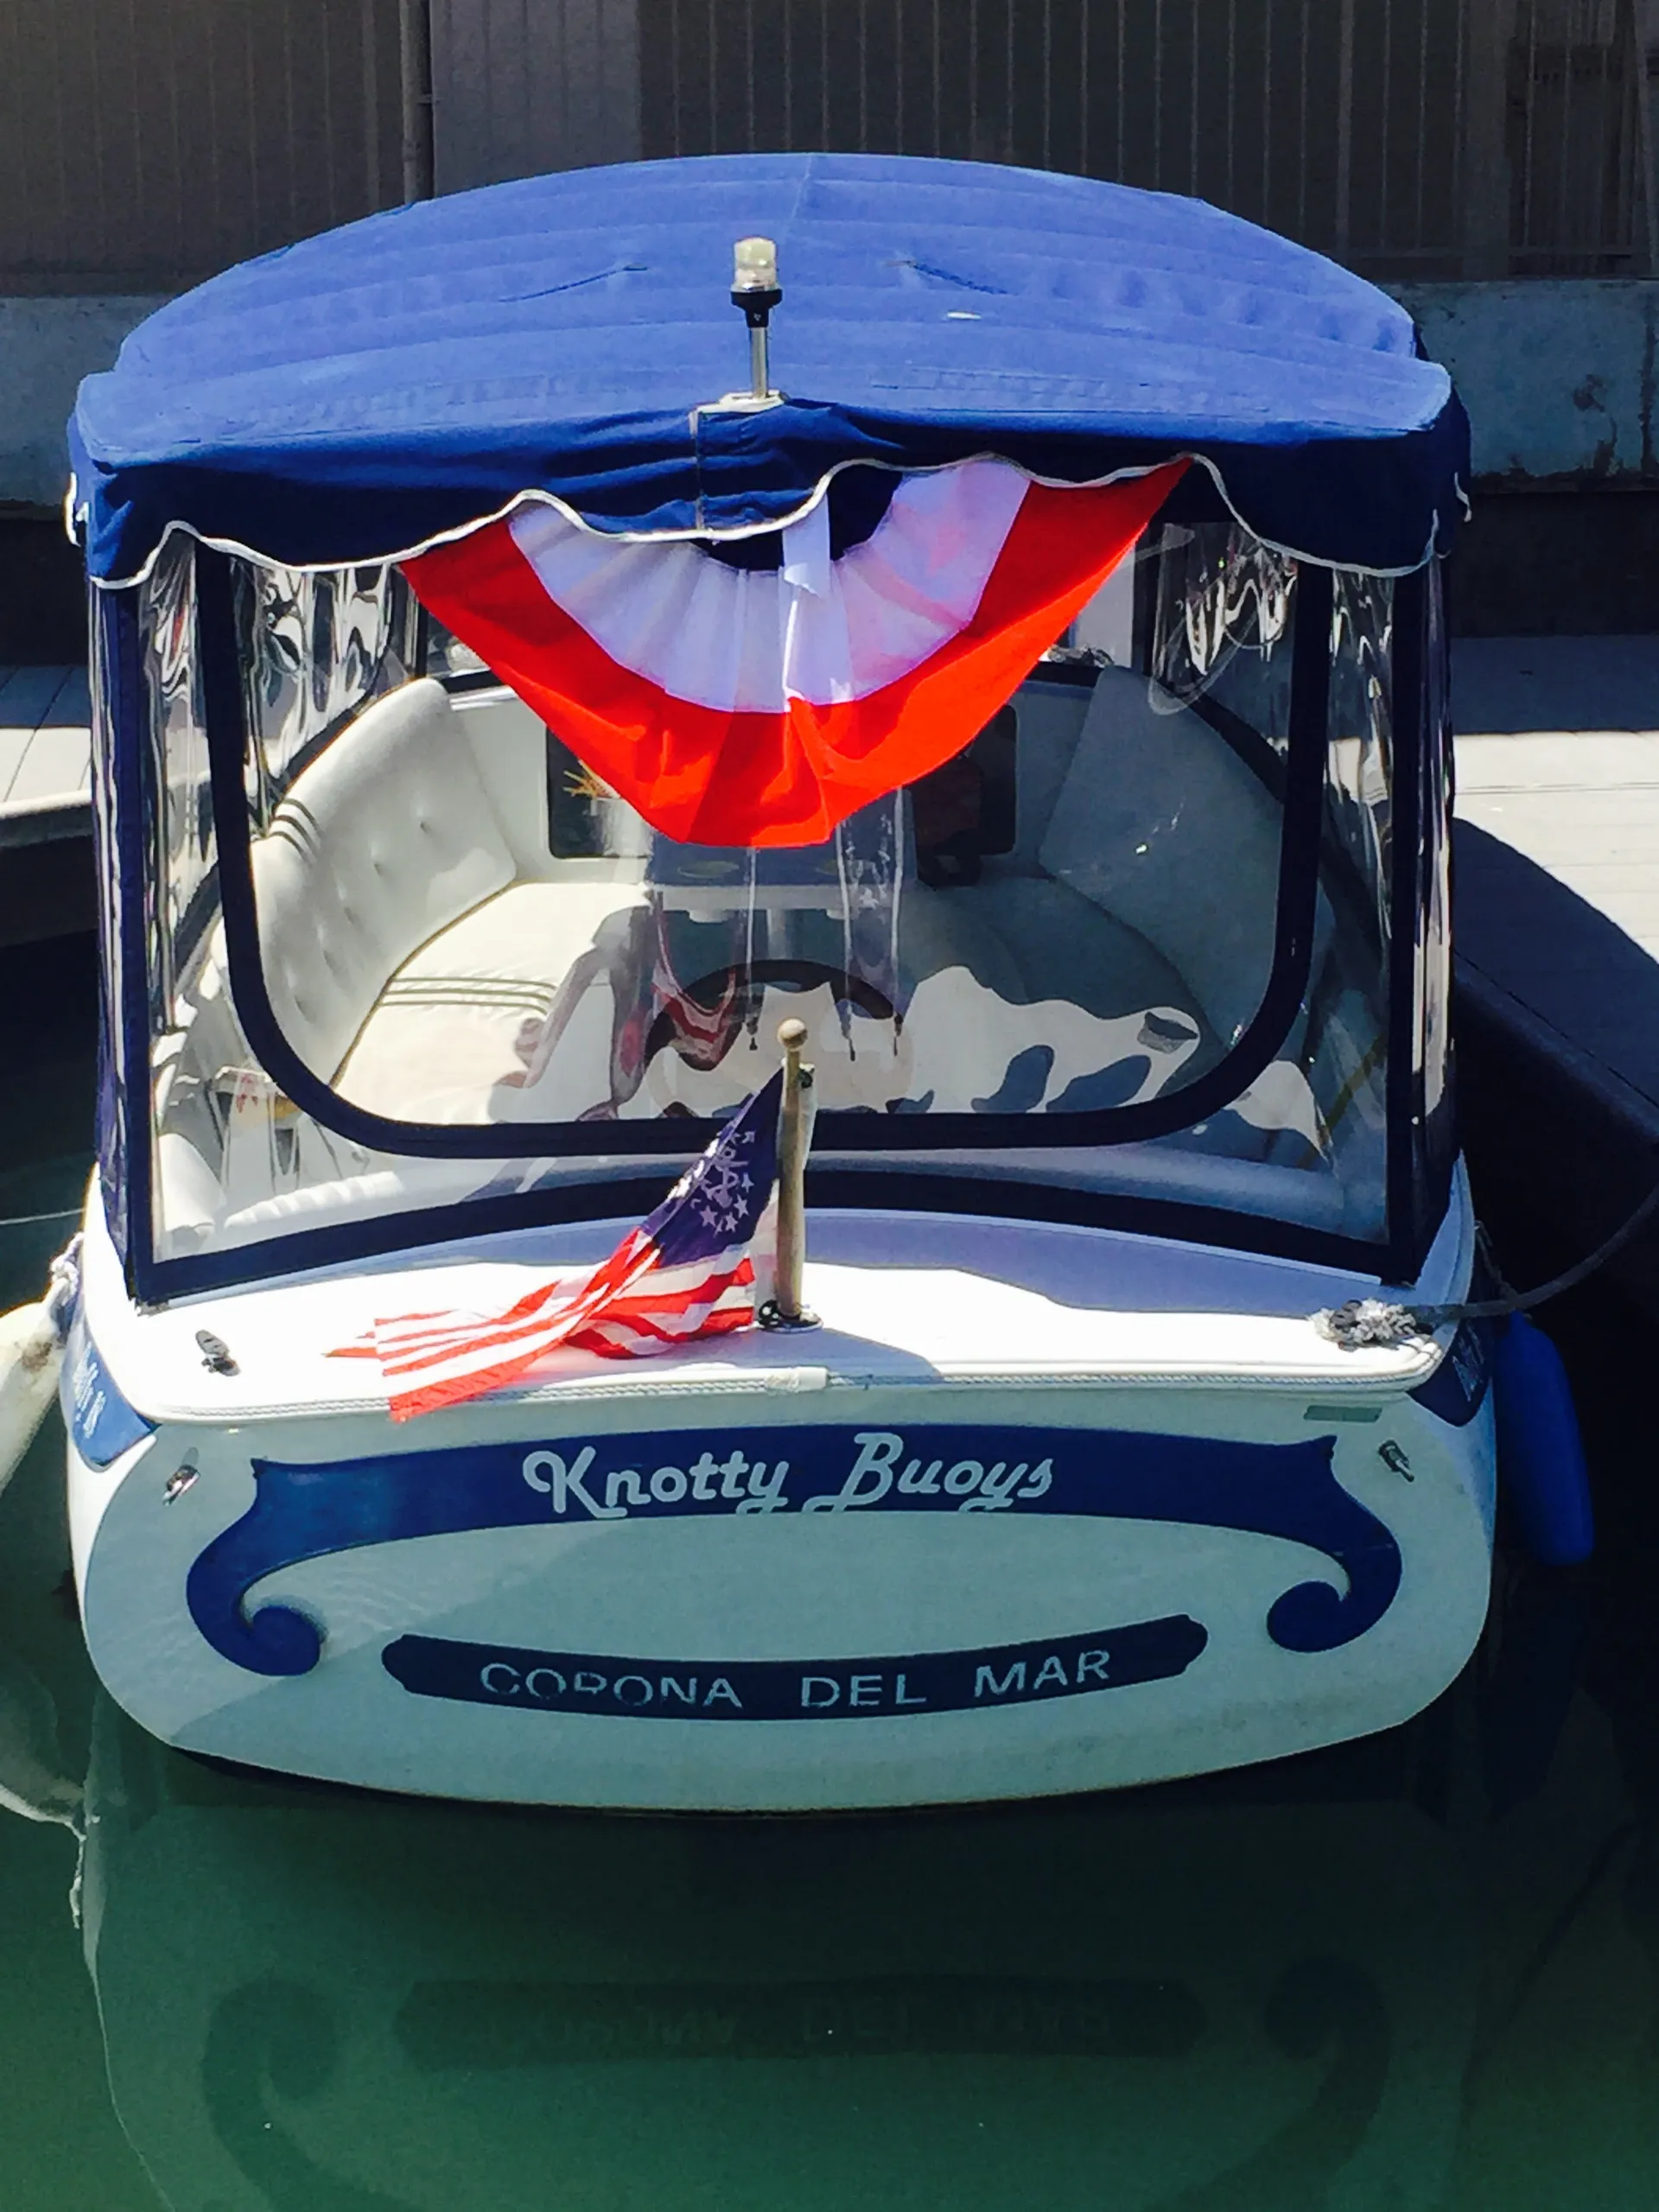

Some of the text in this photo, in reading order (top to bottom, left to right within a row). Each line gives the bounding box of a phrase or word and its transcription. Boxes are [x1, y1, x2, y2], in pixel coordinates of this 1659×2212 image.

[522, 1432, 1053, 1518] Knotty Buoys
[800, 1674, 927, 1707] DEL
[974, 1649, 1110, 1697] MAR
